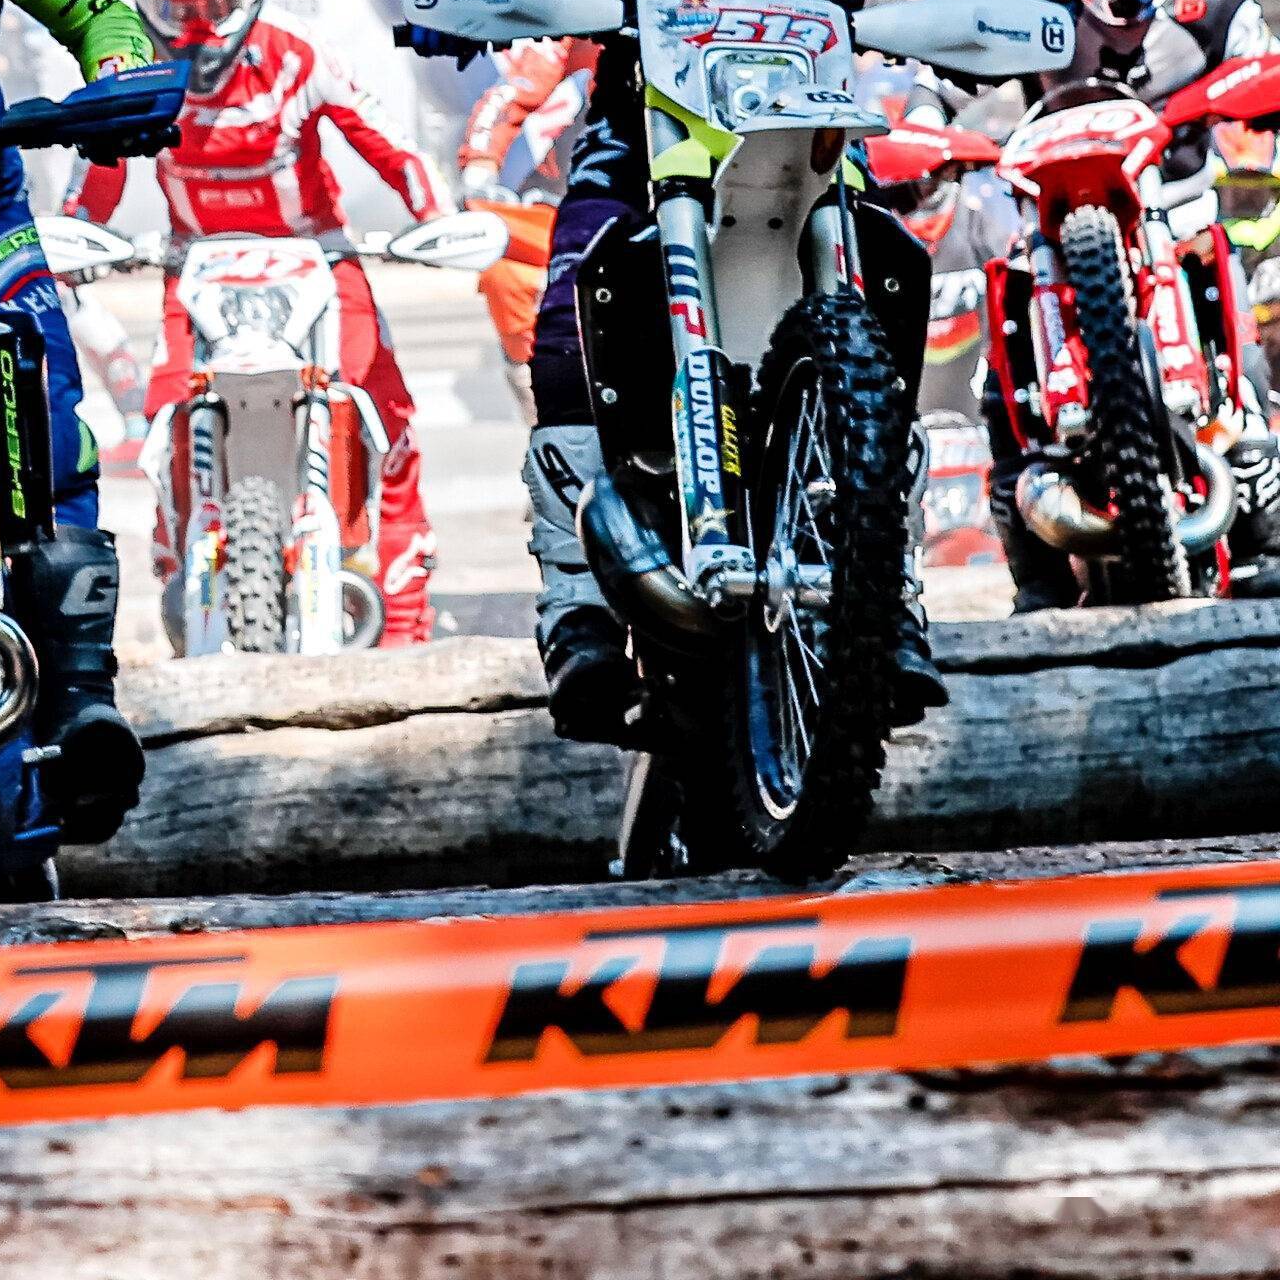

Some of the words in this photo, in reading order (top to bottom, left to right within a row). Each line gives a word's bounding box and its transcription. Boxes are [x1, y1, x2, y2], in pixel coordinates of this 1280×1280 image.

[712, 9, 830, 54] 513
[687, 353, 722, 495] DUNLOP
[485, 918, 912, 1063] KTM
